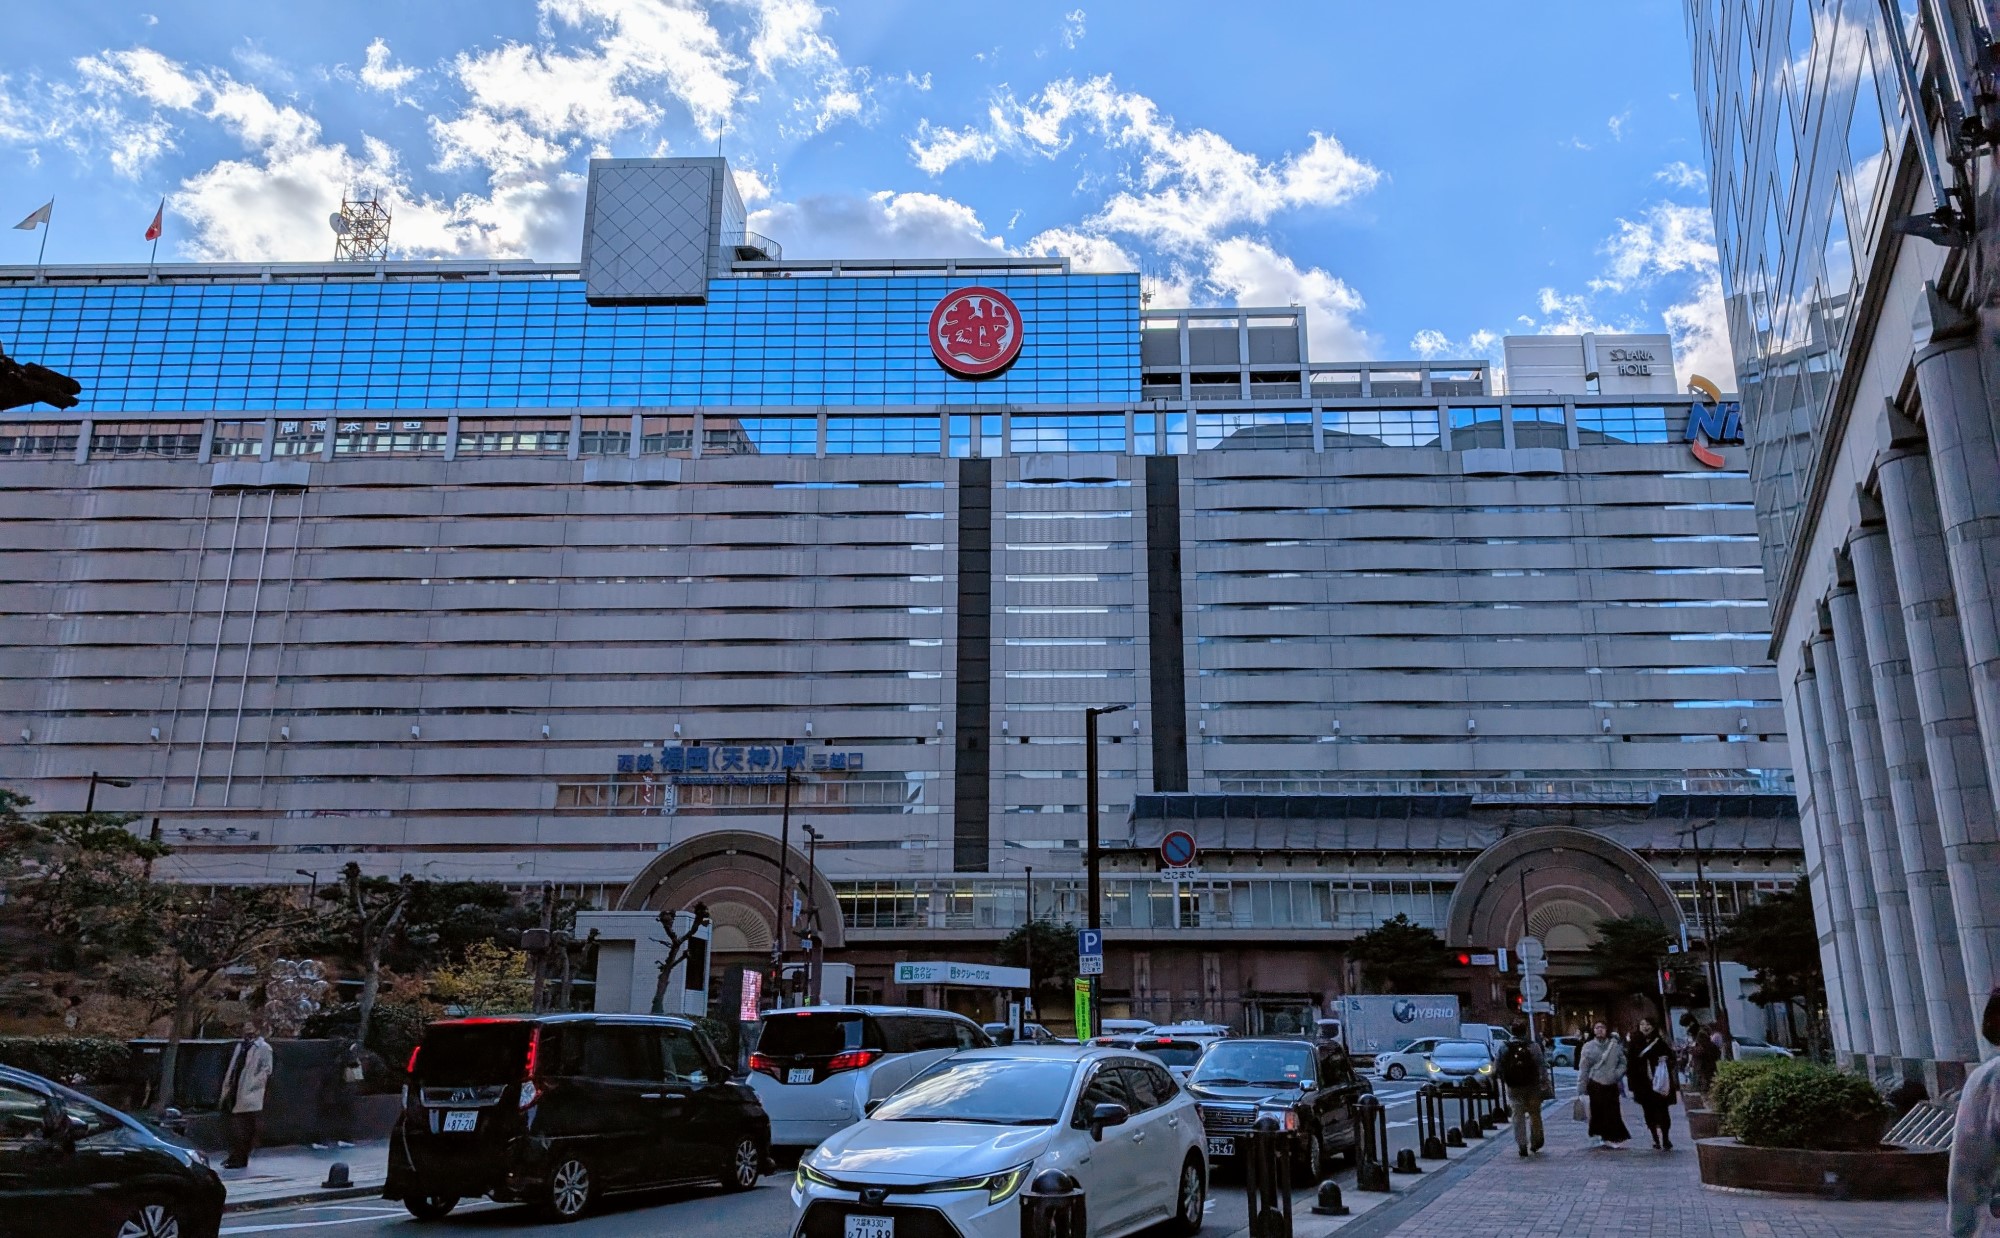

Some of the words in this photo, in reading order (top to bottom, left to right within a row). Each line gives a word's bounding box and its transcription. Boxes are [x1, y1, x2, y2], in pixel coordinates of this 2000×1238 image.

[1610, 349, 1655, 361] SOLARIA
[1618, 364, 1652, 376] HOTEL
[1685, 402, 1744, 440] Ni
[1163, 871, 1194, 880] ここまで
[1084, 932, 1097, 953] P
[956, 968, 990, 980] タクシーのりば
[1408, 1008, 1454, 1019] HYBRID
